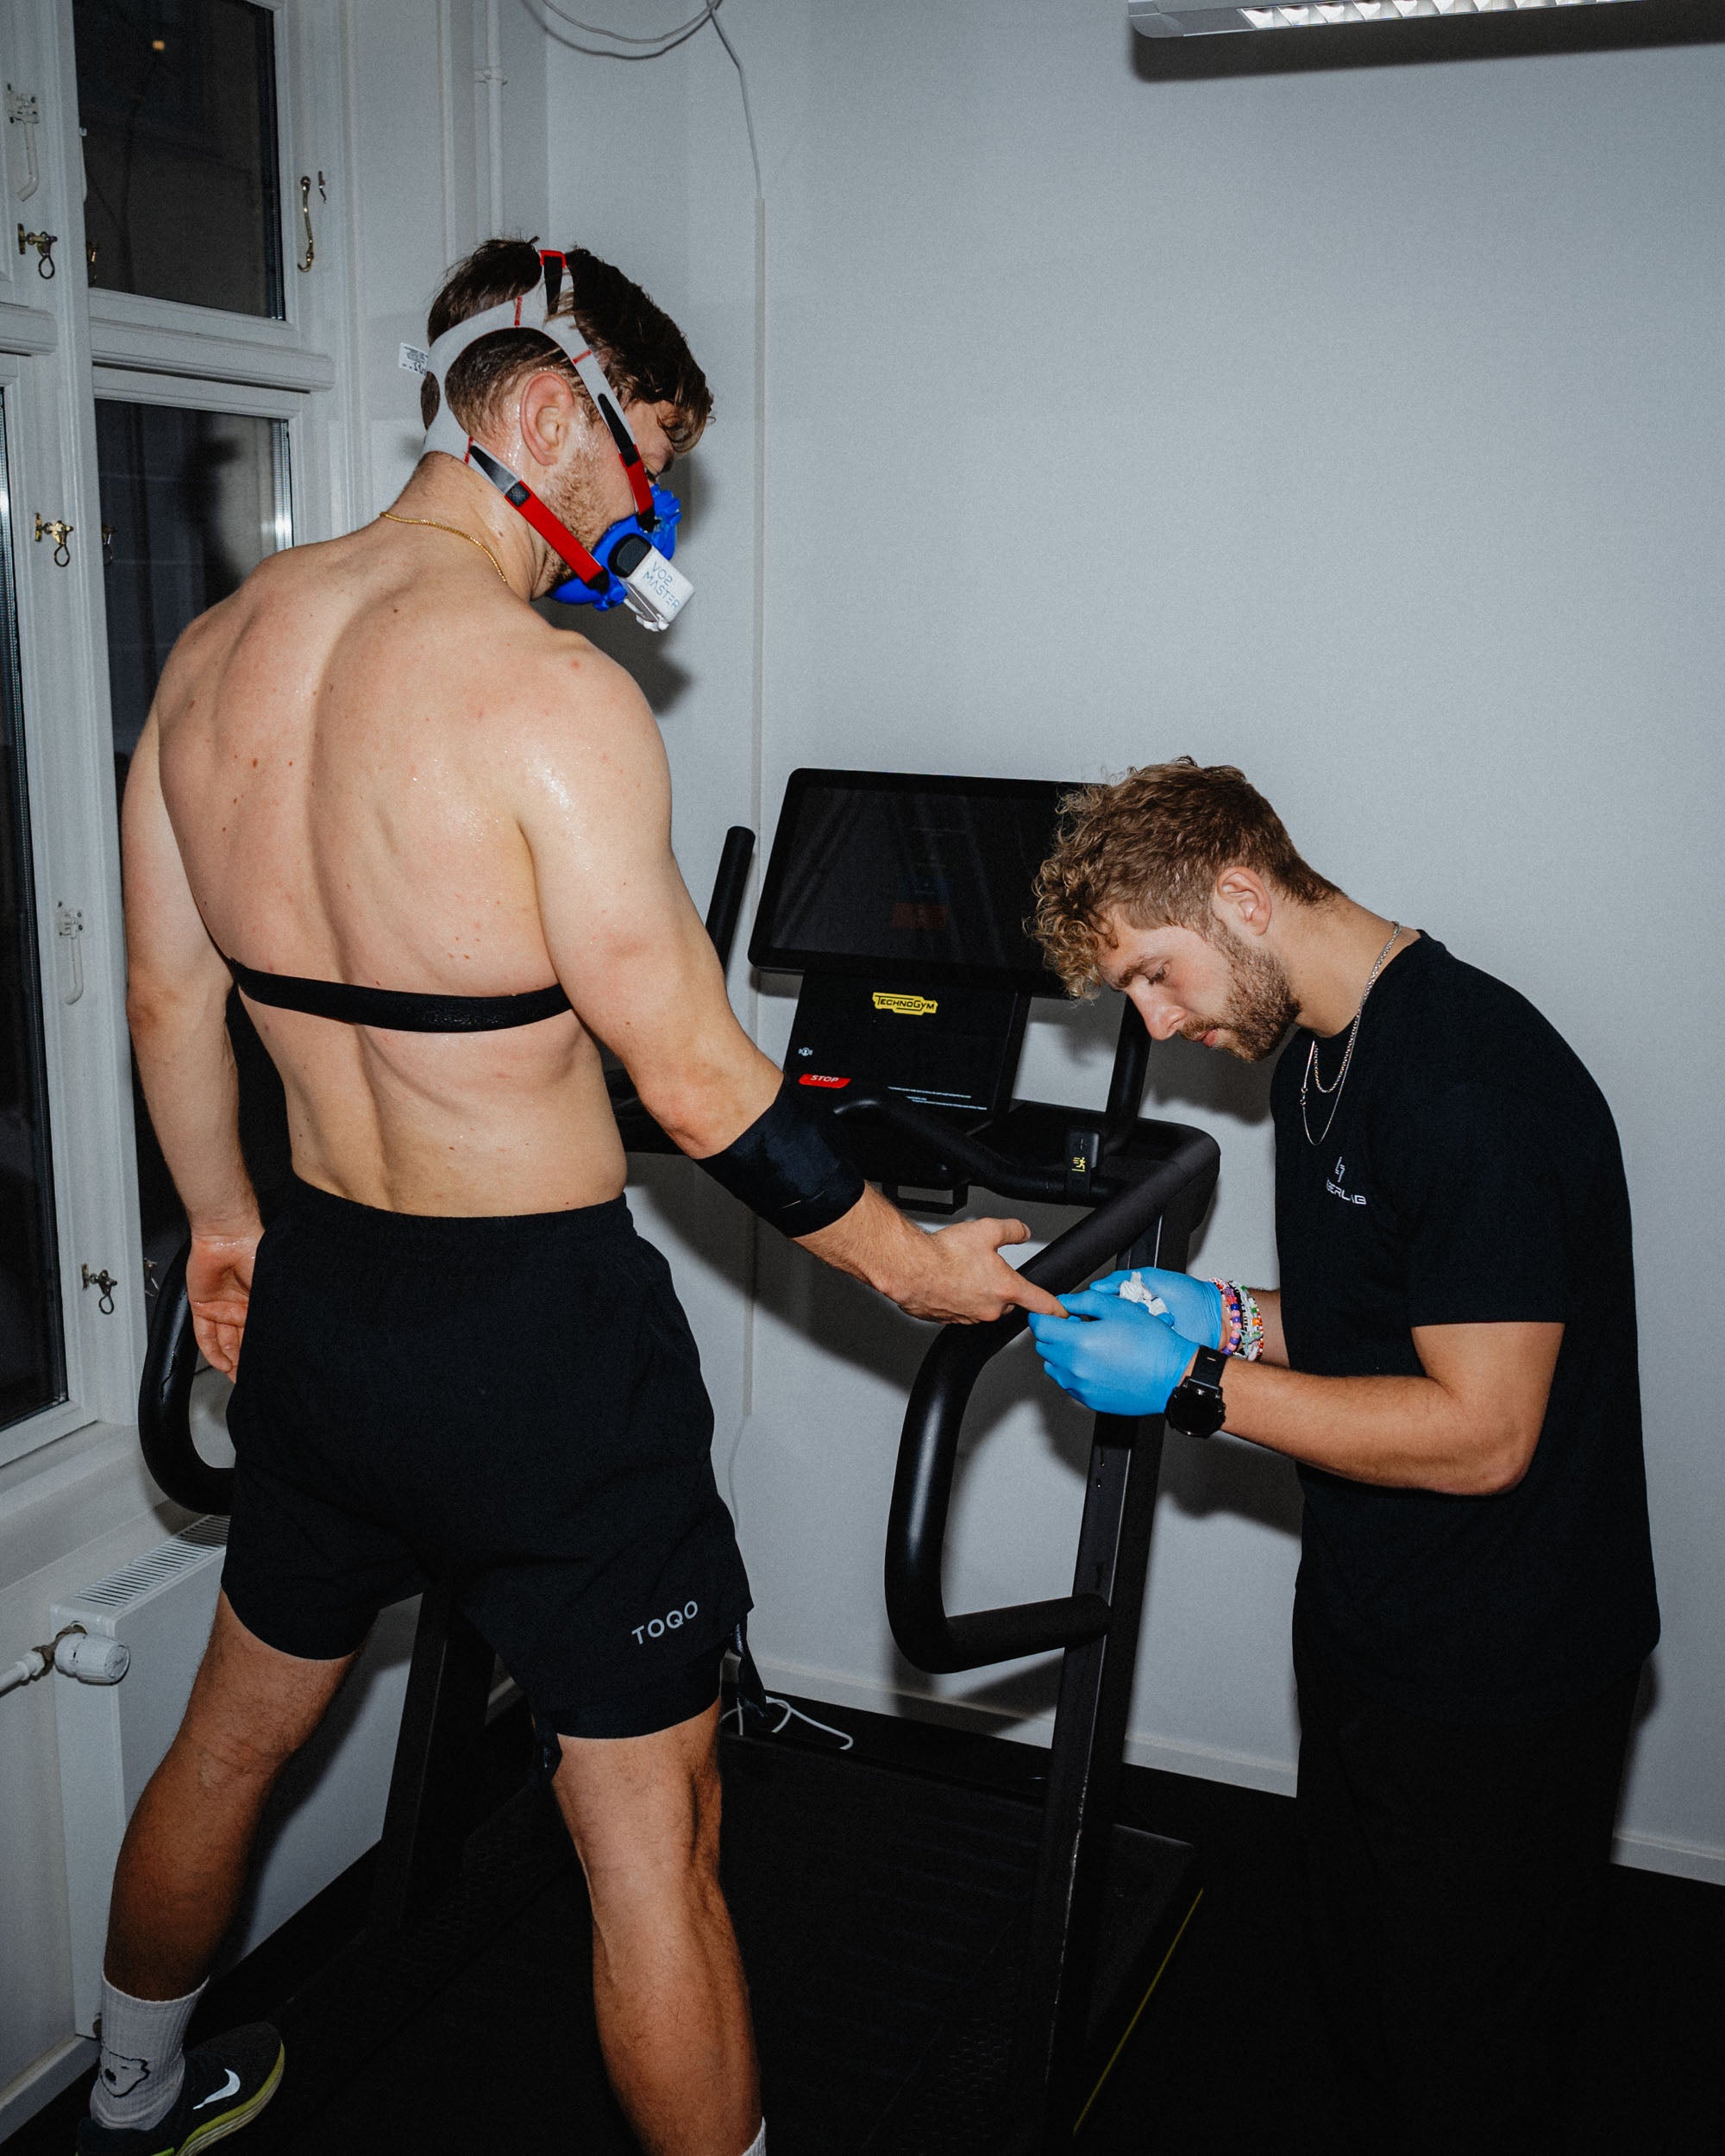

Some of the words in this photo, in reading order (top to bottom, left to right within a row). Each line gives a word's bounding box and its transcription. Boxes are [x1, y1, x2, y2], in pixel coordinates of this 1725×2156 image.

[652, 561, 674, 587] VO2
[643, 571, 681, 611] MASTER
[875, 994, 935, 1011] TECHNOGYM
[631, 1600, 699, 1645] TOQO
